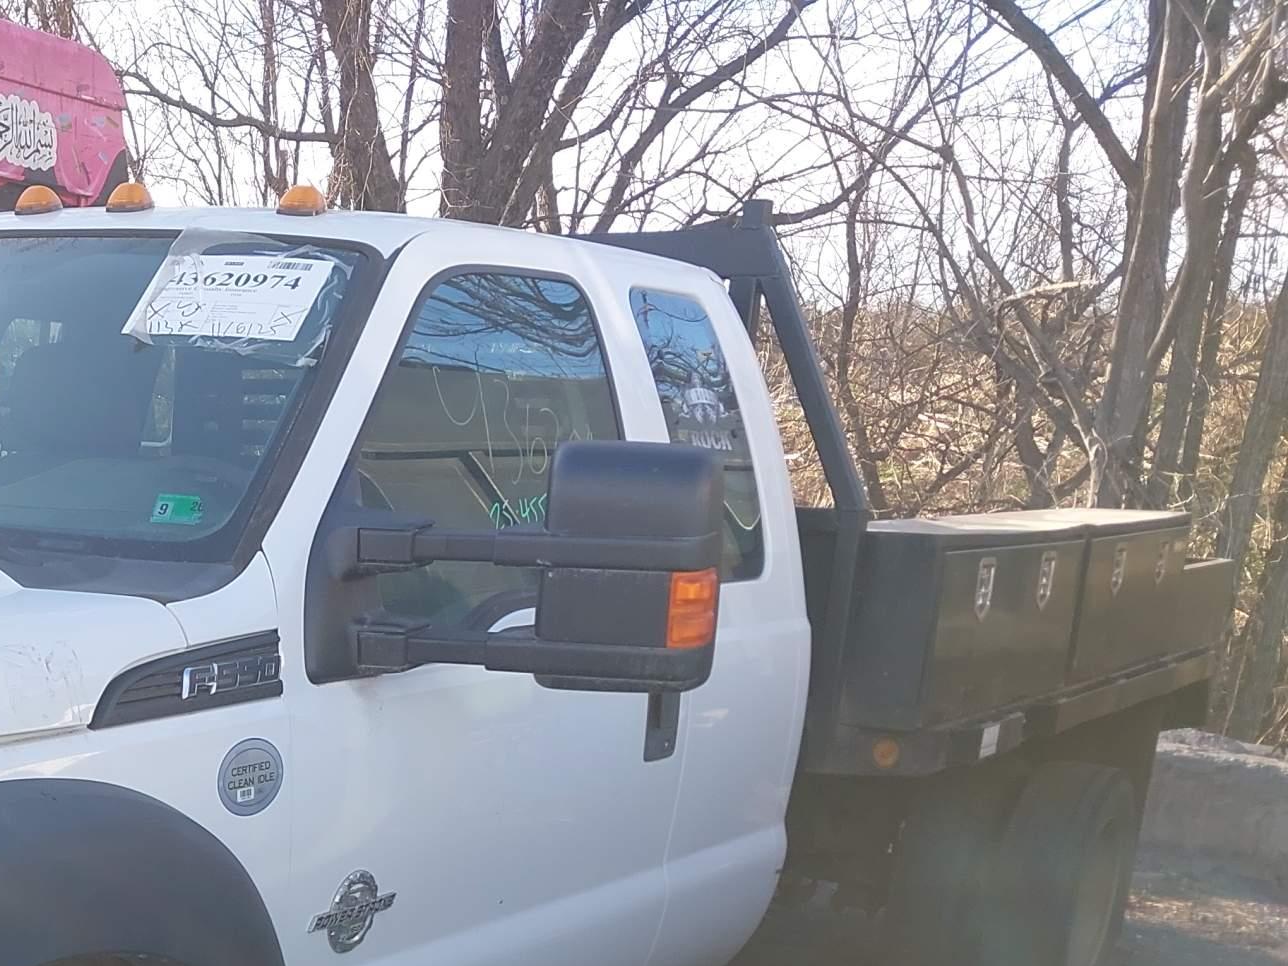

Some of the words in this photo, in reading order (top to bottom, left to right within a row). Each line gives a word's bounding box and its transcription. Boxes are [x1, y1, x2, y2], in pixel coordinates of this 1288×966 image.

[169, 272, 301, 290] 43620974
[158, 503, 169, 515] 9
[231, 760, 271, 777] CERTIFIED
[227, 777, 255, 791] CLEAN
[257, 772, 276, 784] IDLE
